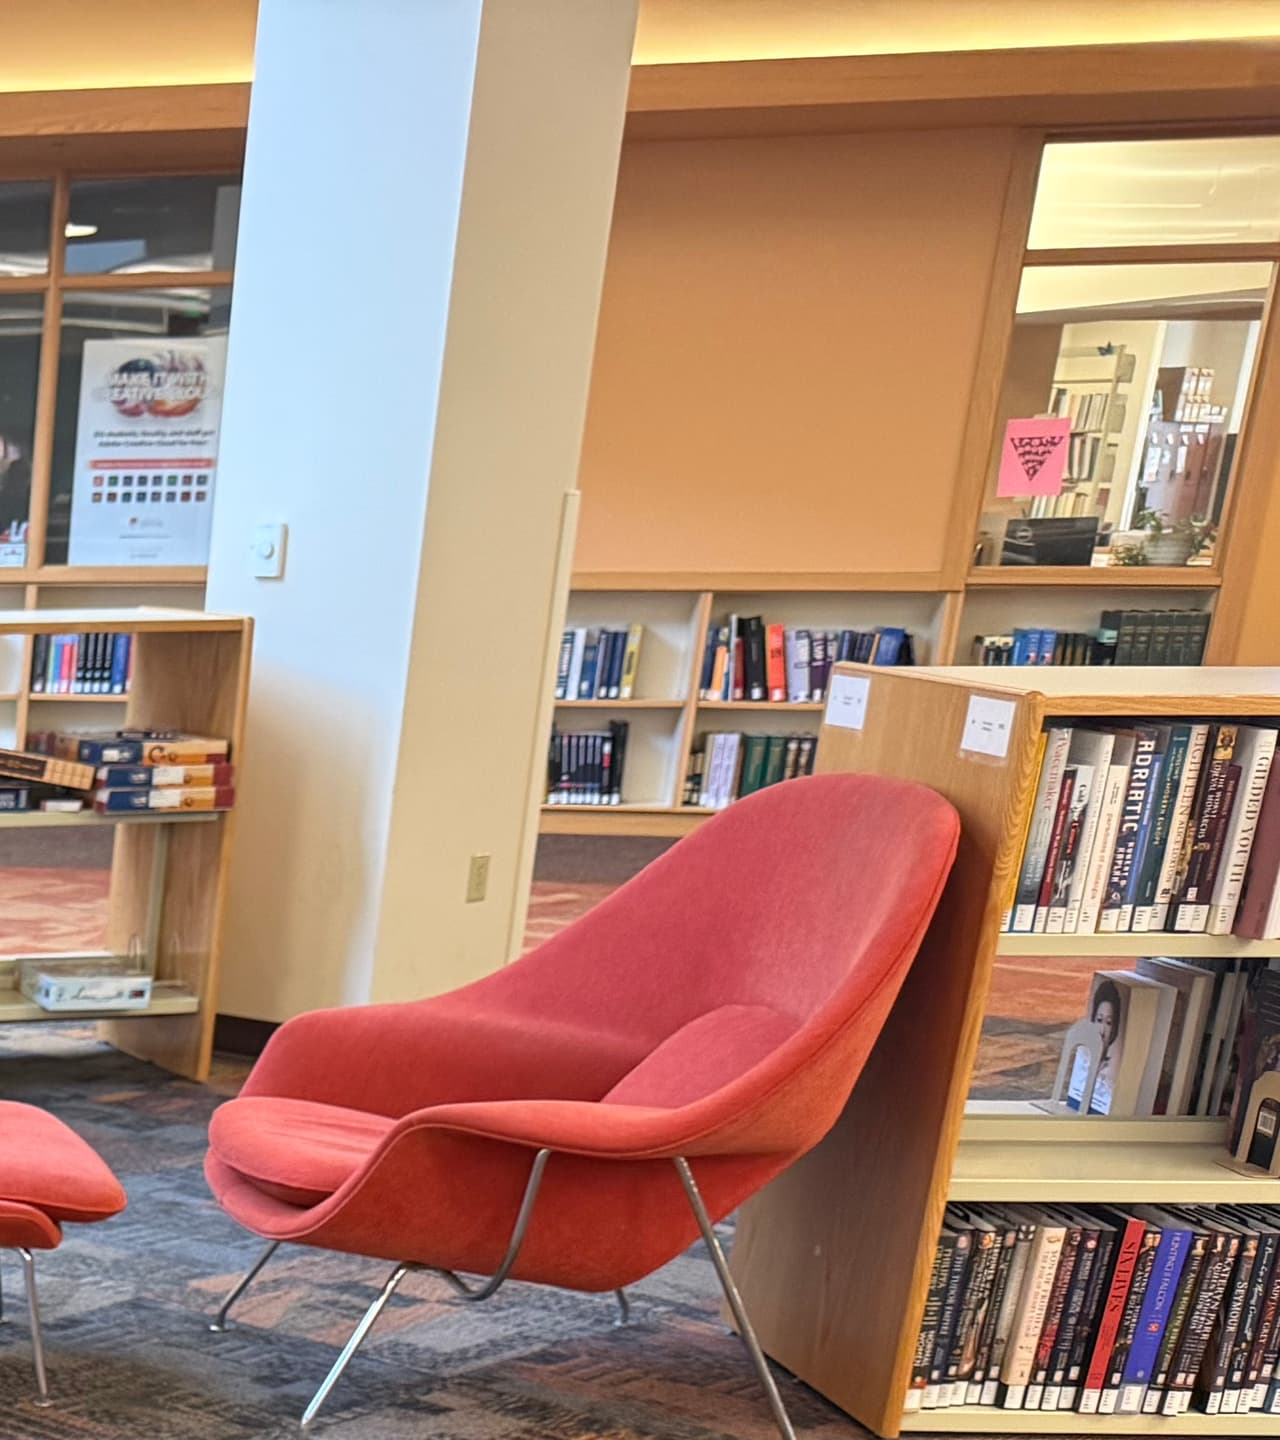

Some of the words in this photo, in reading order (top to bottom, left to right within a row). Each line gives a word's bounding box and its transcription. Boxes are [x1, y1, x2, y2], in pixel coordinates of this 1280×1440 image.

[1044, 734, 1069, 811] Peacemaker
[1122, 737, 1156, 836] ADRIATIC
[1179, 731, 1207, 817] EIGHTEEN
[1245, 756, 1270, 822] GILDED
[1174, 819, 1186, 845] ALICE
[1229, 825, 1253, 884] YOUTH
[1120, 1240, 1137, 1268] SIX
[1164, 1231, 1182, 1273] HUNTING
[1109, 1268, 1130, 1315] LIVES
[1154, 1277, 1169, 1312] FALCON
[1226, 1280, 1248, 1335] SEYMOUR
[1264, 1301, 1277, 1324] JANE
[921, 1330, 935, 1367] NORMAL
[1259, 1322, 1272, 1345] GREY
